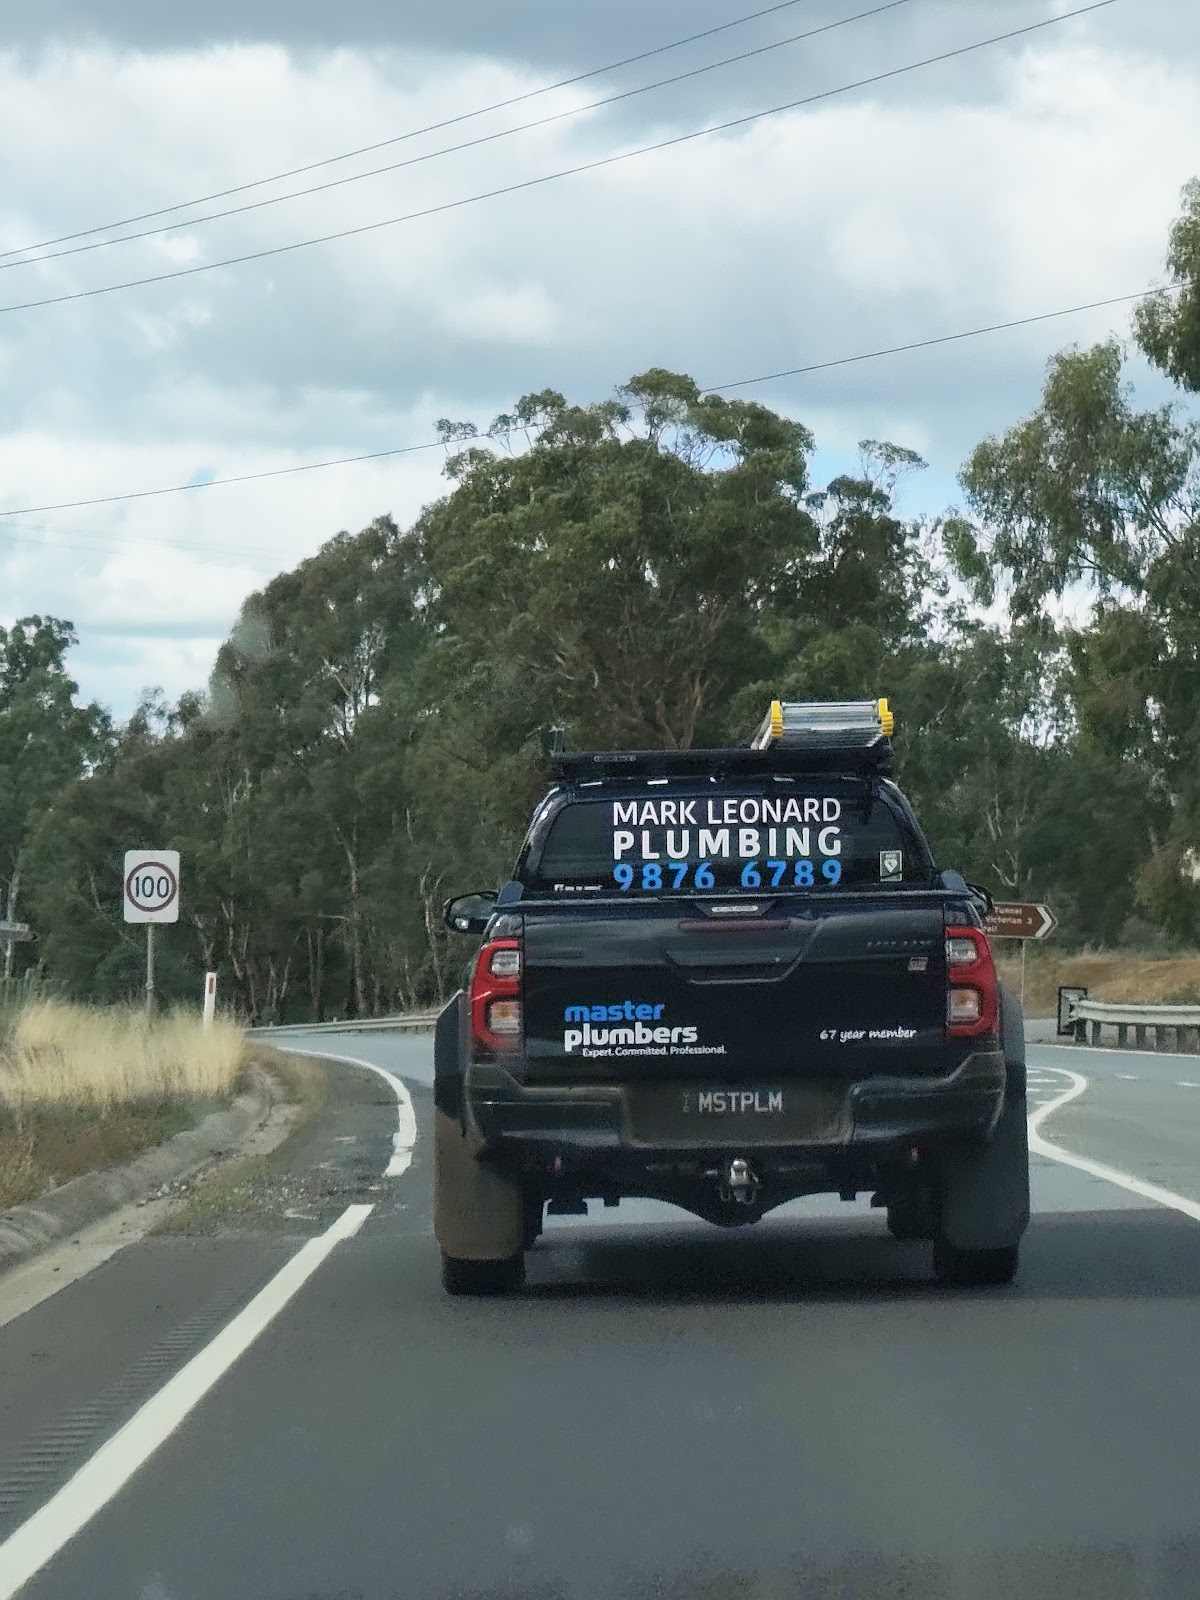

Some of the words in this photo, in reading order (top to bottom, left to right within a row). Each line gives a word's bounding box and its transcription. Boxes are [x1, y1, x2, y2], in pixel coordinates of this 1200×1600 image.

[612, 799, 697, 826] MARK
[706, 797, 842, 825] LEONARD
[612, 826, 842, 860] PLUMBING
[135, 875, 170, 898] 100
[613, 862, 715, 892] 9876
[740, 859, 843, 888] 6789
[564, 1000, 665, 1022] master
[564, 1022, 698, 1052] plumbers
[820, 1029, 837, 1040] 67
[839, 1030, 866, 1043] year
[868, 1025, 917, 1039] member
[698, 1091, 783, 1112] MSTPLM
